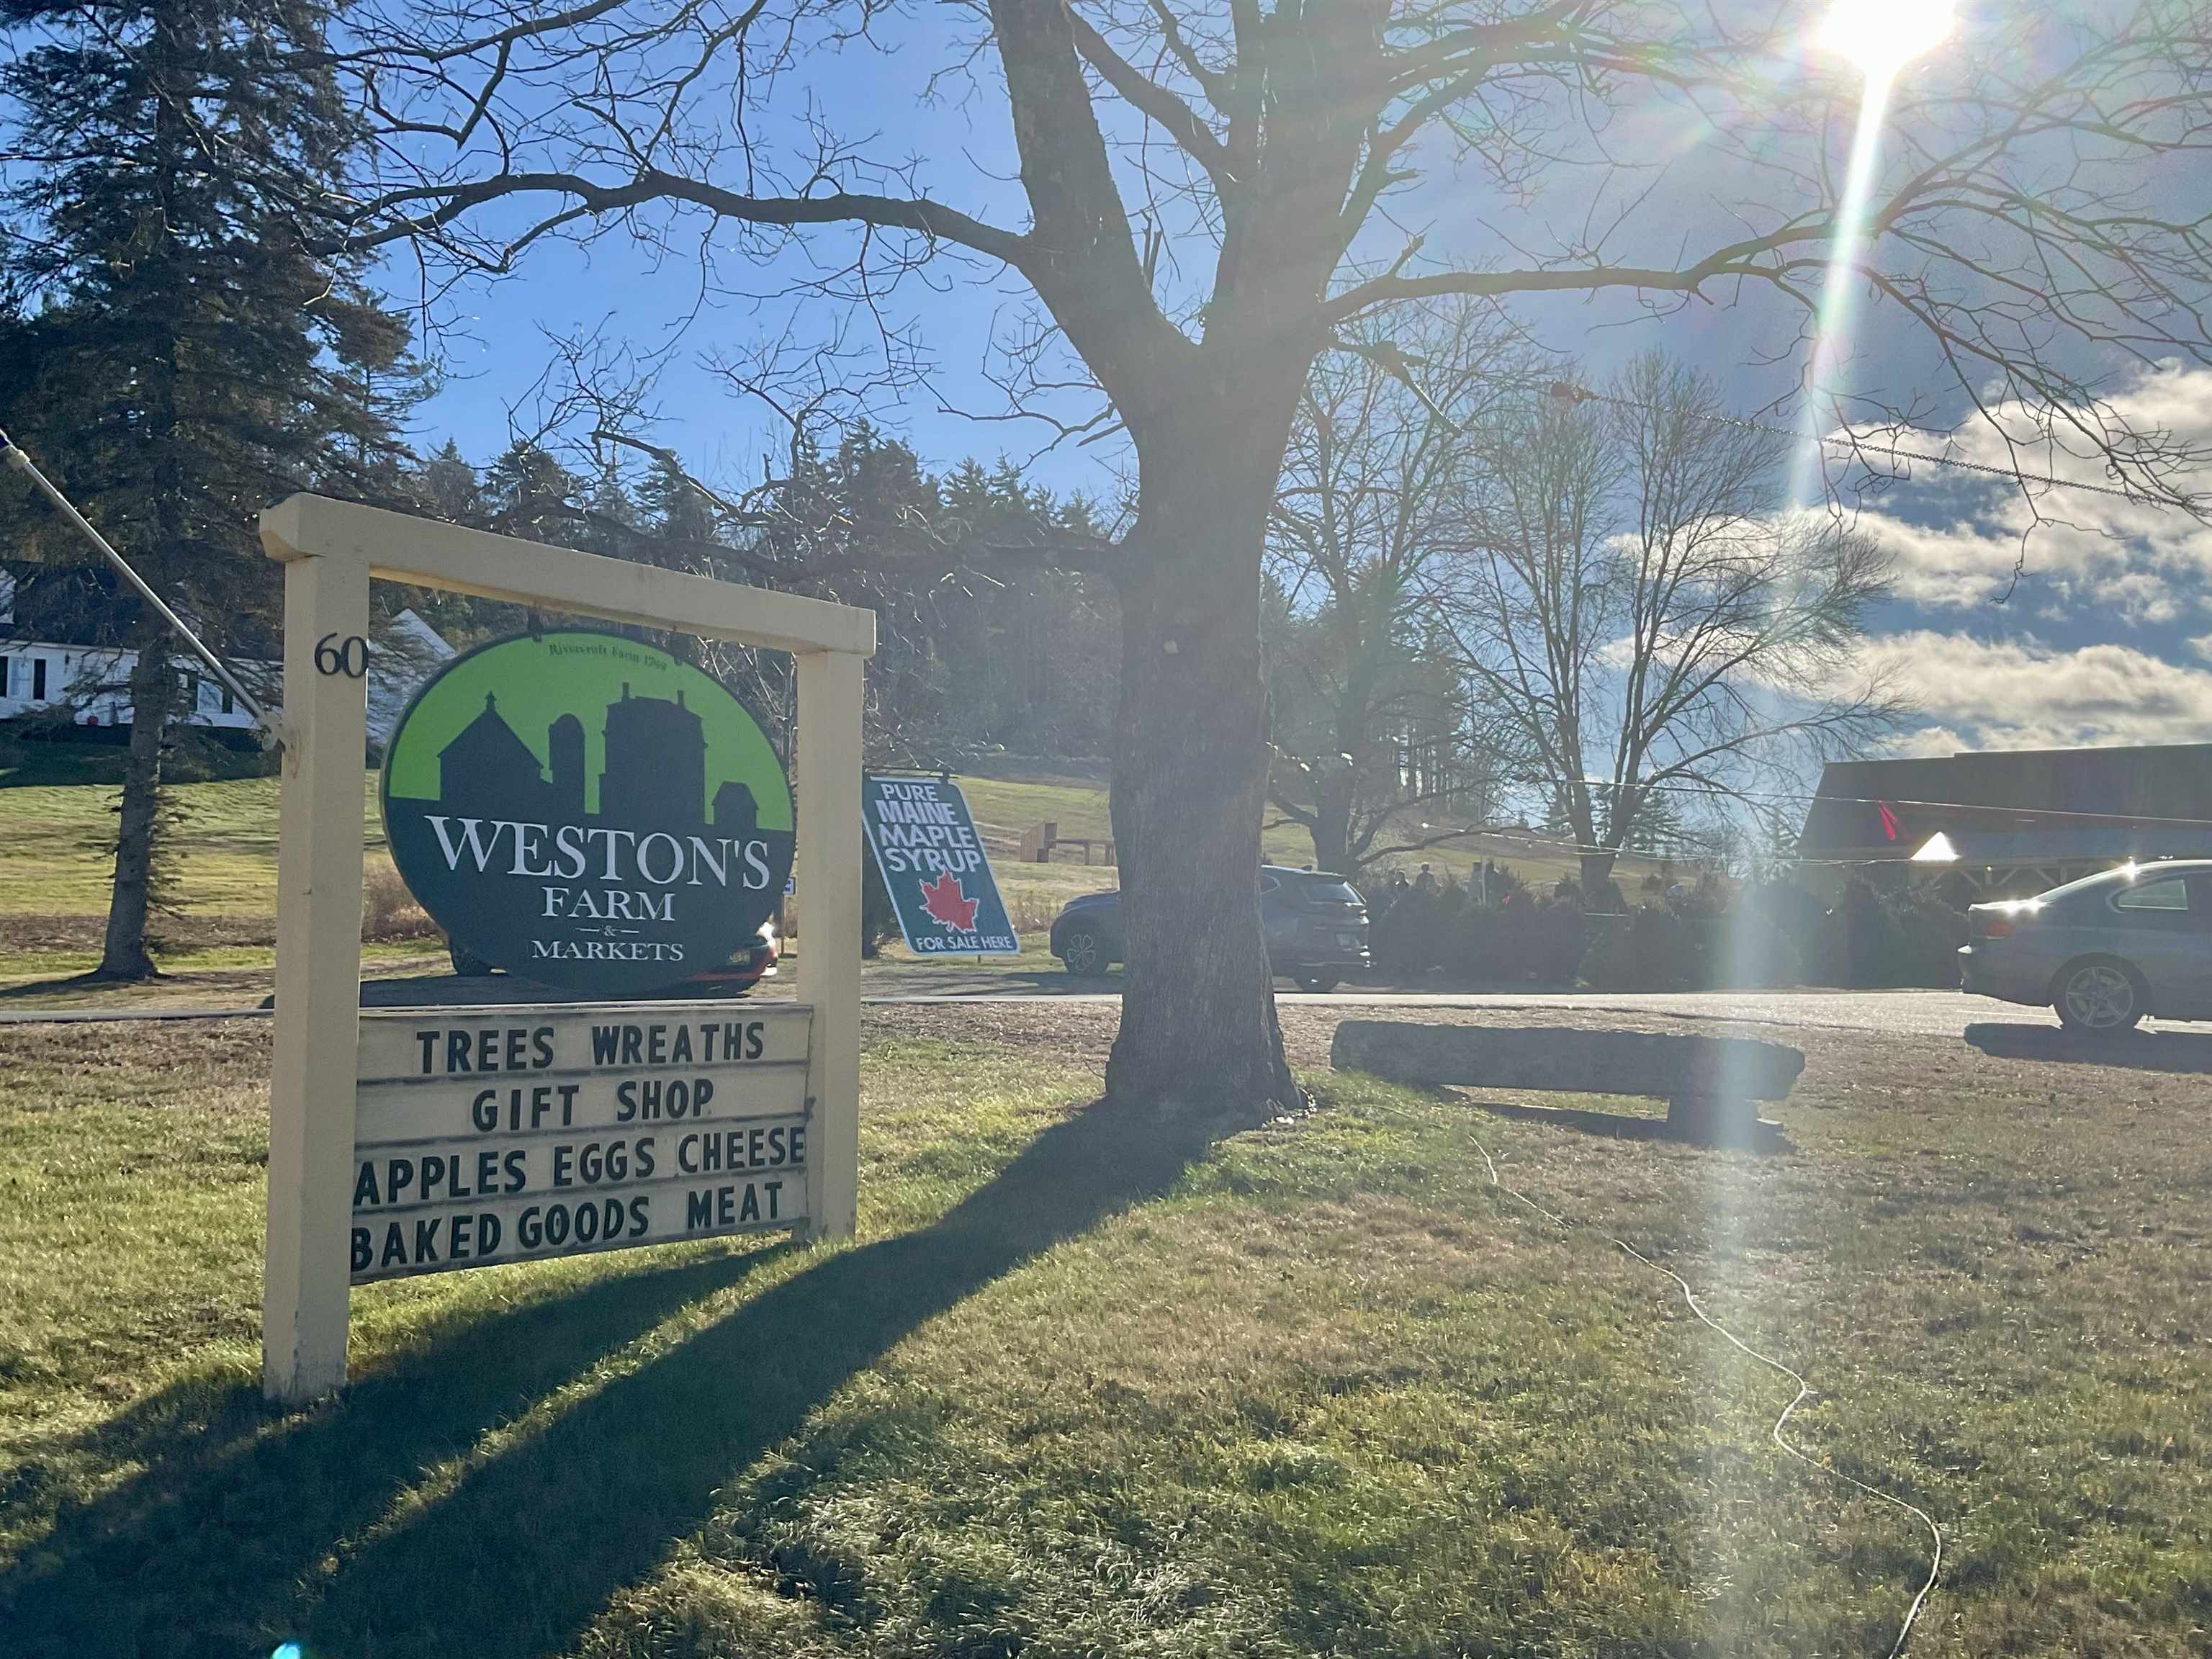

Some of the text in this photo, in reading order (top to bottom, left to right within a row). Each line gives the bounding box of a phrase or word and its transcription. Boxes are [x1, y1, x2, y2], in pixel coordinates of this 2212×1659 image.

[315, 632, 369, 678] 60
[611, 646, 639, 663] Farm
[881, 783, 940, 802] PURE
[875, 800, 960, 825] MAINE
[878, 823, 976, 849] MAPLE
[423, 814, 770, 890] WESTON'S
[884, 848, 981, 873] SYRUP
[541, 886, 675, 922] FARM
[604, 925, 616, 937] &
[915, 936, 1013, 950] FOR SALE HERE
[531, 940, 683, 962] MARKETS
[416, 1022, 764, 1074] TREES WREATHS
[472, 1079, 714, 1132] GIFT SHOP
[353, 1126, 806, 1206] APPLES EGGS CHEESE
[350, 1181, 783, 1272] BAKED GOODS MEAT
